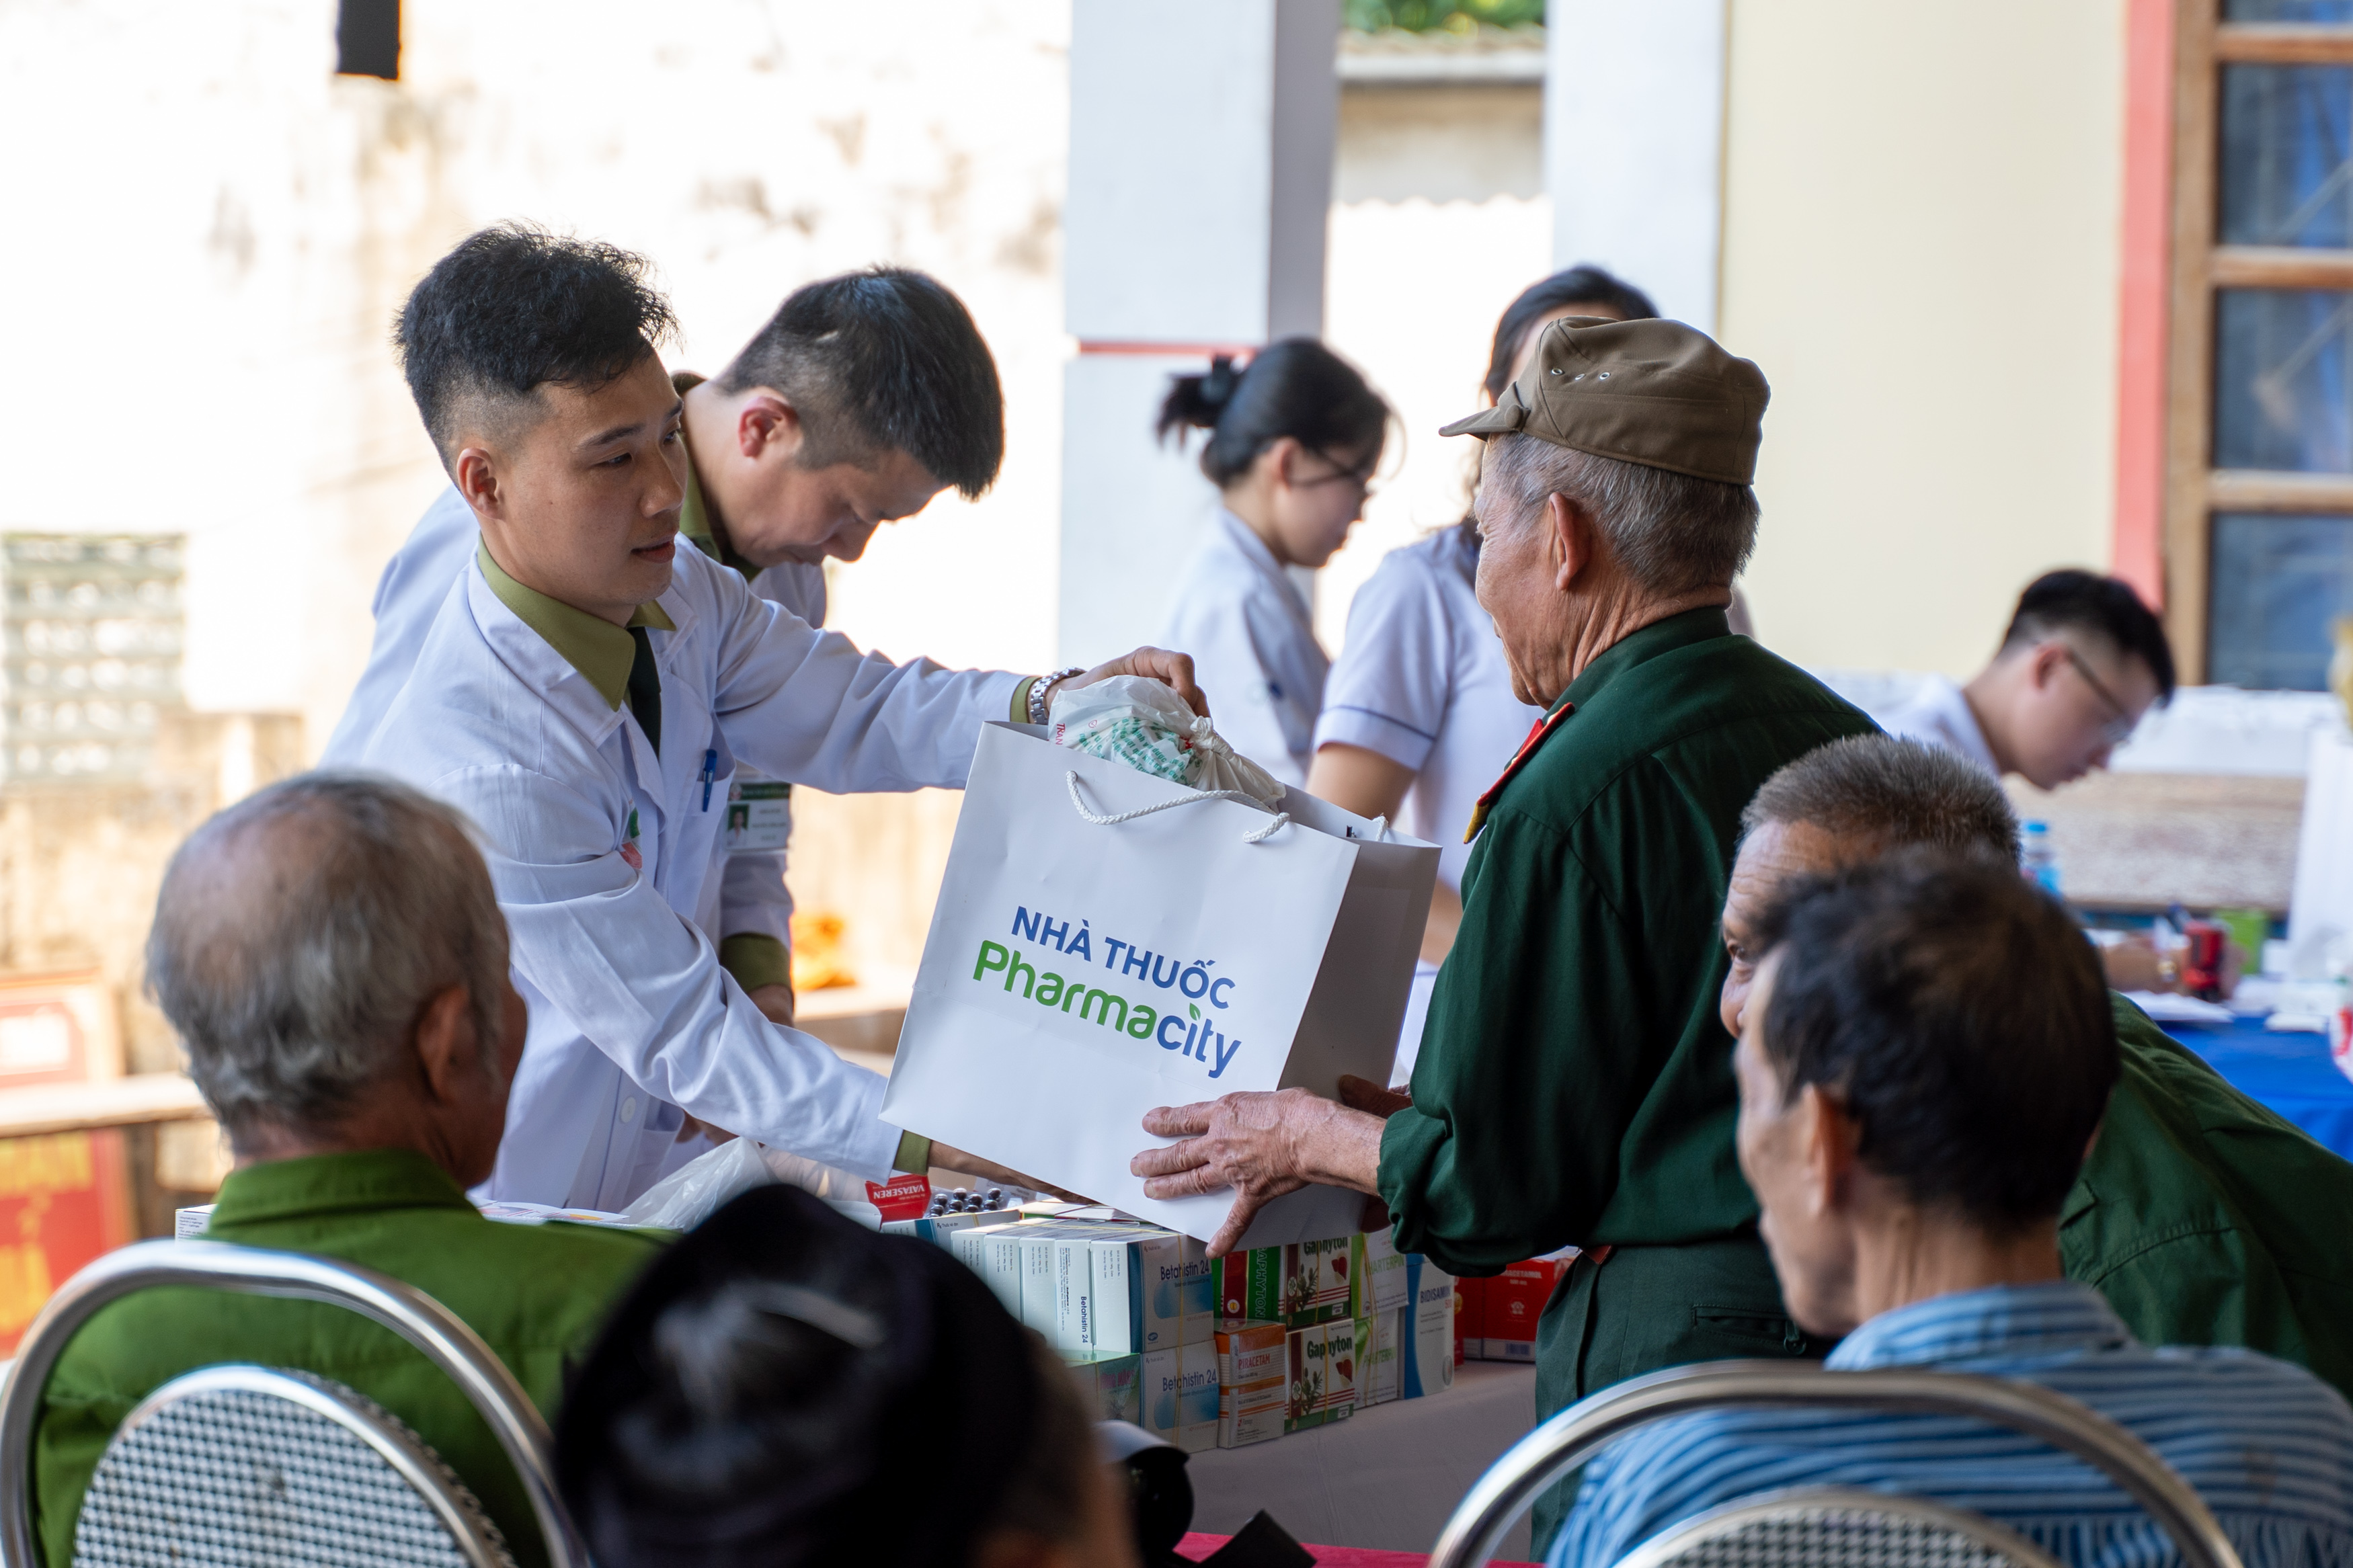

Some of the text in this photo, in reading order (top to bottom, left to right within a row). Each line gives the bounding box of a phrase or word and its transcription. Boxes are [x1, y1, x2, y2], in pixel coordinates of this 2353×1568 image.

[1011, 906, 1236, 1009] NHÀ THUỐC
[973, 940, 1242, 1079] Pharmacity
[873, 1184, 925, 1200] VATASEREN
[1160, 1259, 1210, 1281] Betahistin 24
[1080, 1296, 1089, 1344] Betahistin 24
[1238, 1354, 1271, 1370] PIRACETAM
[1162, 1368, 1217, 1392] Betahistin 24
